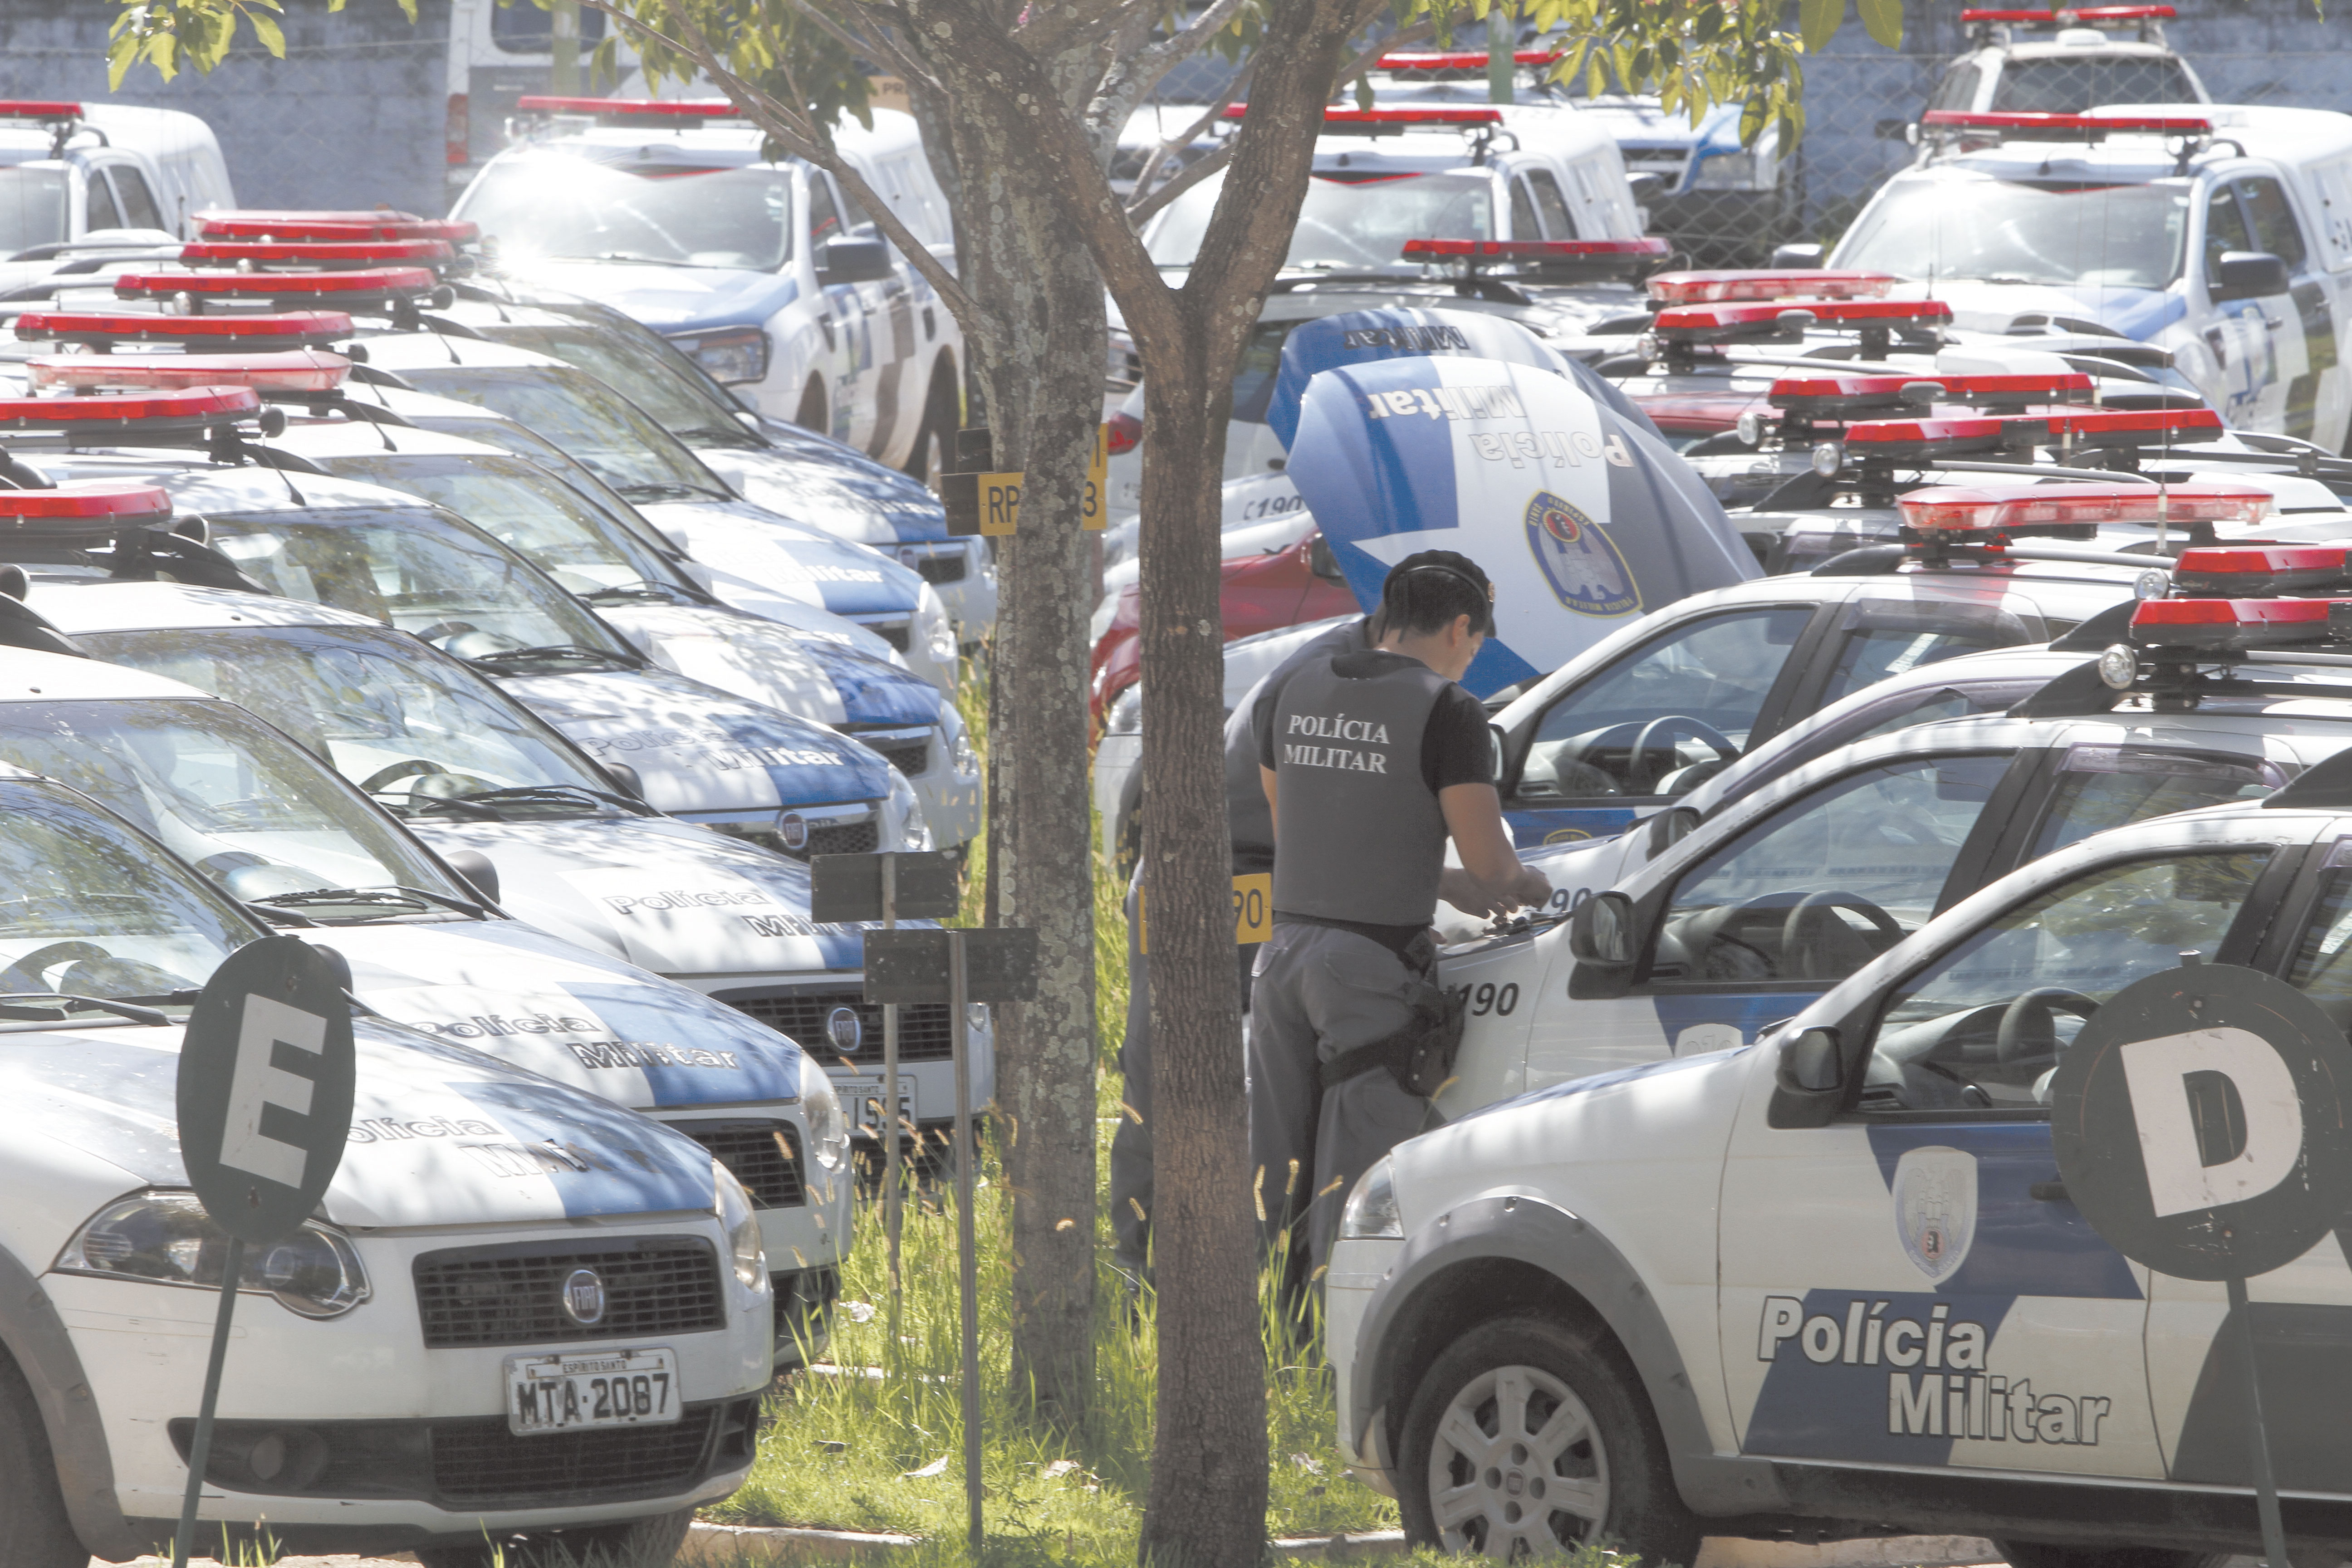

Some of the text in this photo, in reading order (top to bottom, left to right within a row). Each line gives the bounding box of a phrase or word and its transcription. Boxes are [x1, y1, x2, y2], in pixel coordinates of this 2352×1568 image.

[1366, 386, 1528, 421] Militar
[1467, 431, 1635, 469] Polícia
[574, 728, 735, 757] Polícia
[1287, 713, 1391, 744] POLÍCIA
[698, 746, 845, 770] Militar
[1284, 744, 1387, 774] MILITAR
[601, 889, 774, 915] Polícia
[565, 1041, 742, 1069] Militar
[218, 992, 328, 1190] E
[346, 1116, 504, 1143] olícia
[2120, 1027, 2303, 1218] D
[573, 1285, 597, 1310] FIAT
[1758, 1295, 1987, 1372] Polícia
[1888, 1371, 2112, 1446] Militar
